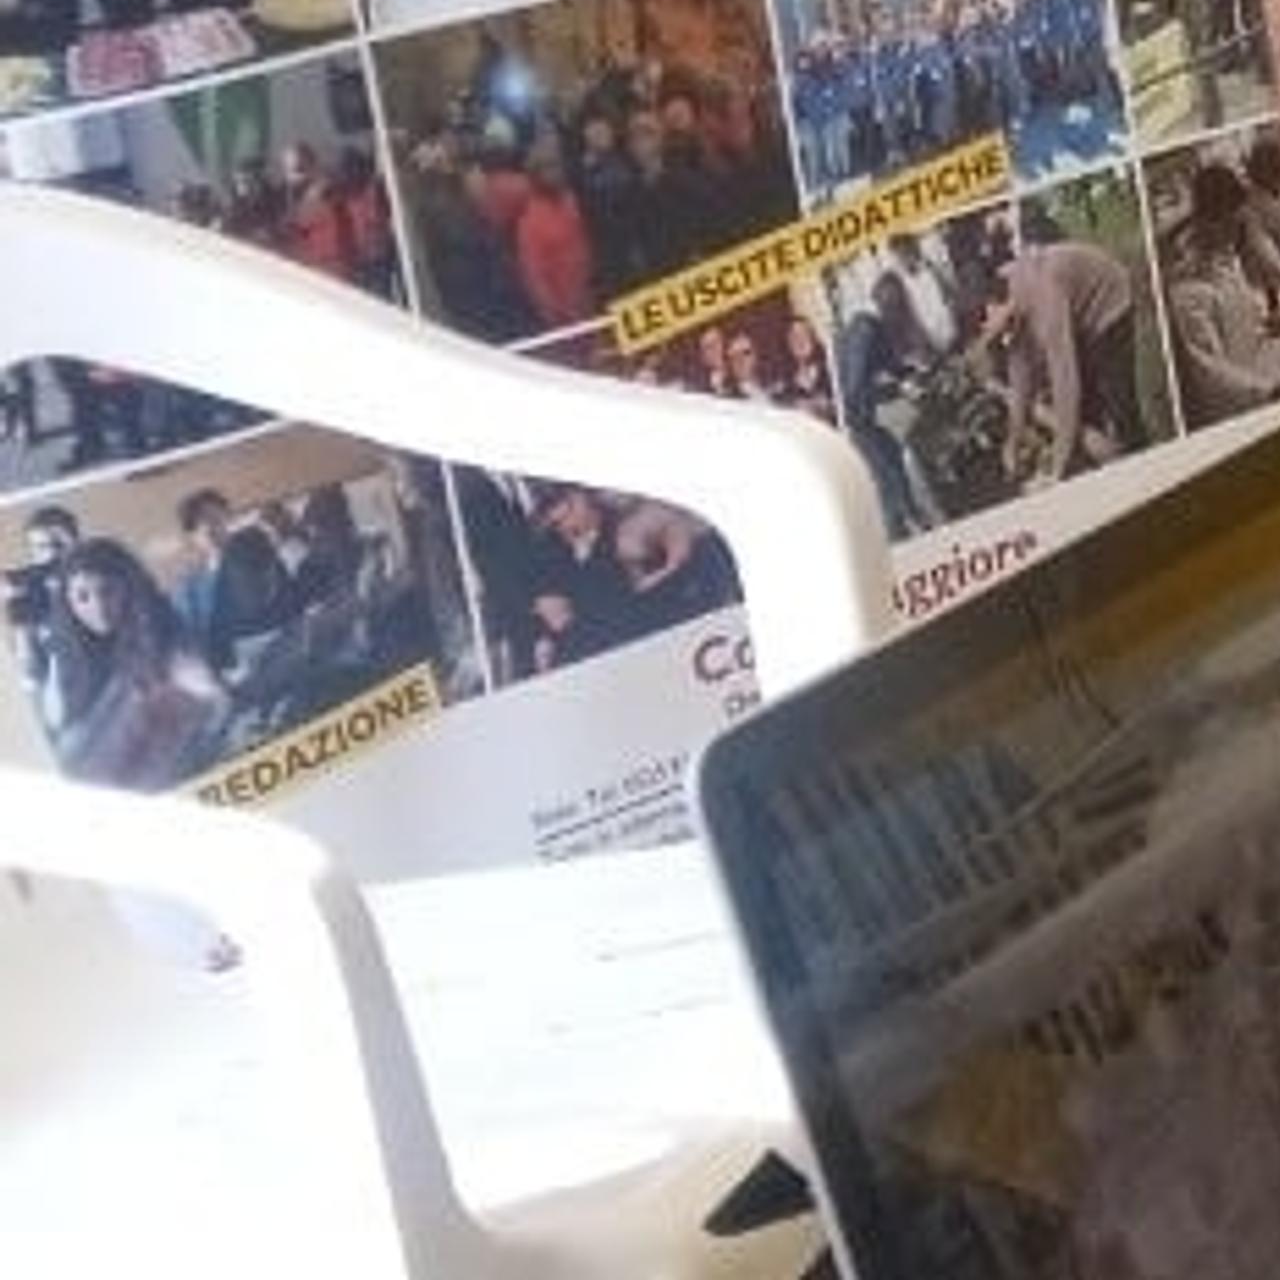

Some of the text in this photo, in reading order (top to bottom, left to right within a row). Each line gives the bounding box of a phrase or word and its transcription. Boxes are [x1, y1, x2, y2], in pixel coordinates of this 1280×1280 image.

[619, 145, 1004, 340] LE USCITE DIDATTICHE
[196, 678, 430, 808] REDAZIONE
